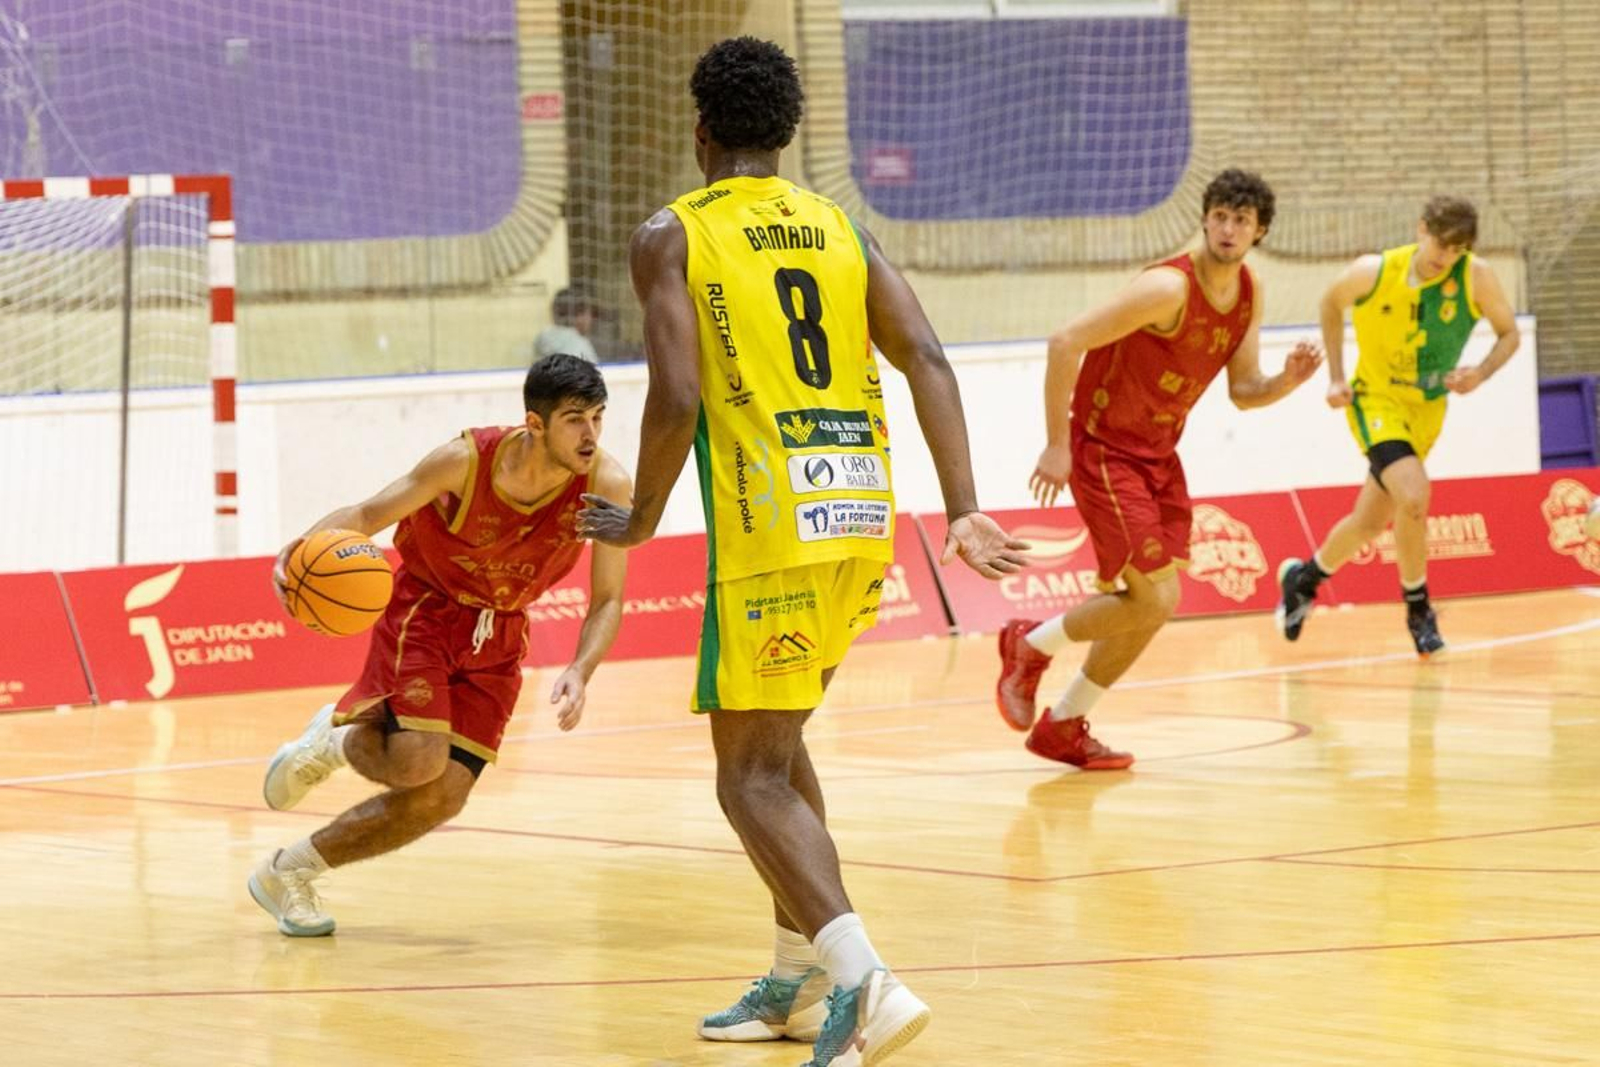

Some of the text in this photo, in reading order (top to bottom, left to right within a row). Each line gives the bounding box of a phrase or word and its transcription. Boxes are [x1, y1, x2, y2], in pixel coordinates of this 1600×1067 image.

[743, 224, 825, 252] BAMADU
[706, 283, 738, 359] RUSTER
[774, 267, 832, 390] 8
[841, 456, 875, 472] ORO
[835, 512, 886, 524] LA FORTUNA
[167, 619, 286, 645] DIPUTACIÓN
[173, 643, 253, 666] DE JAÉN
